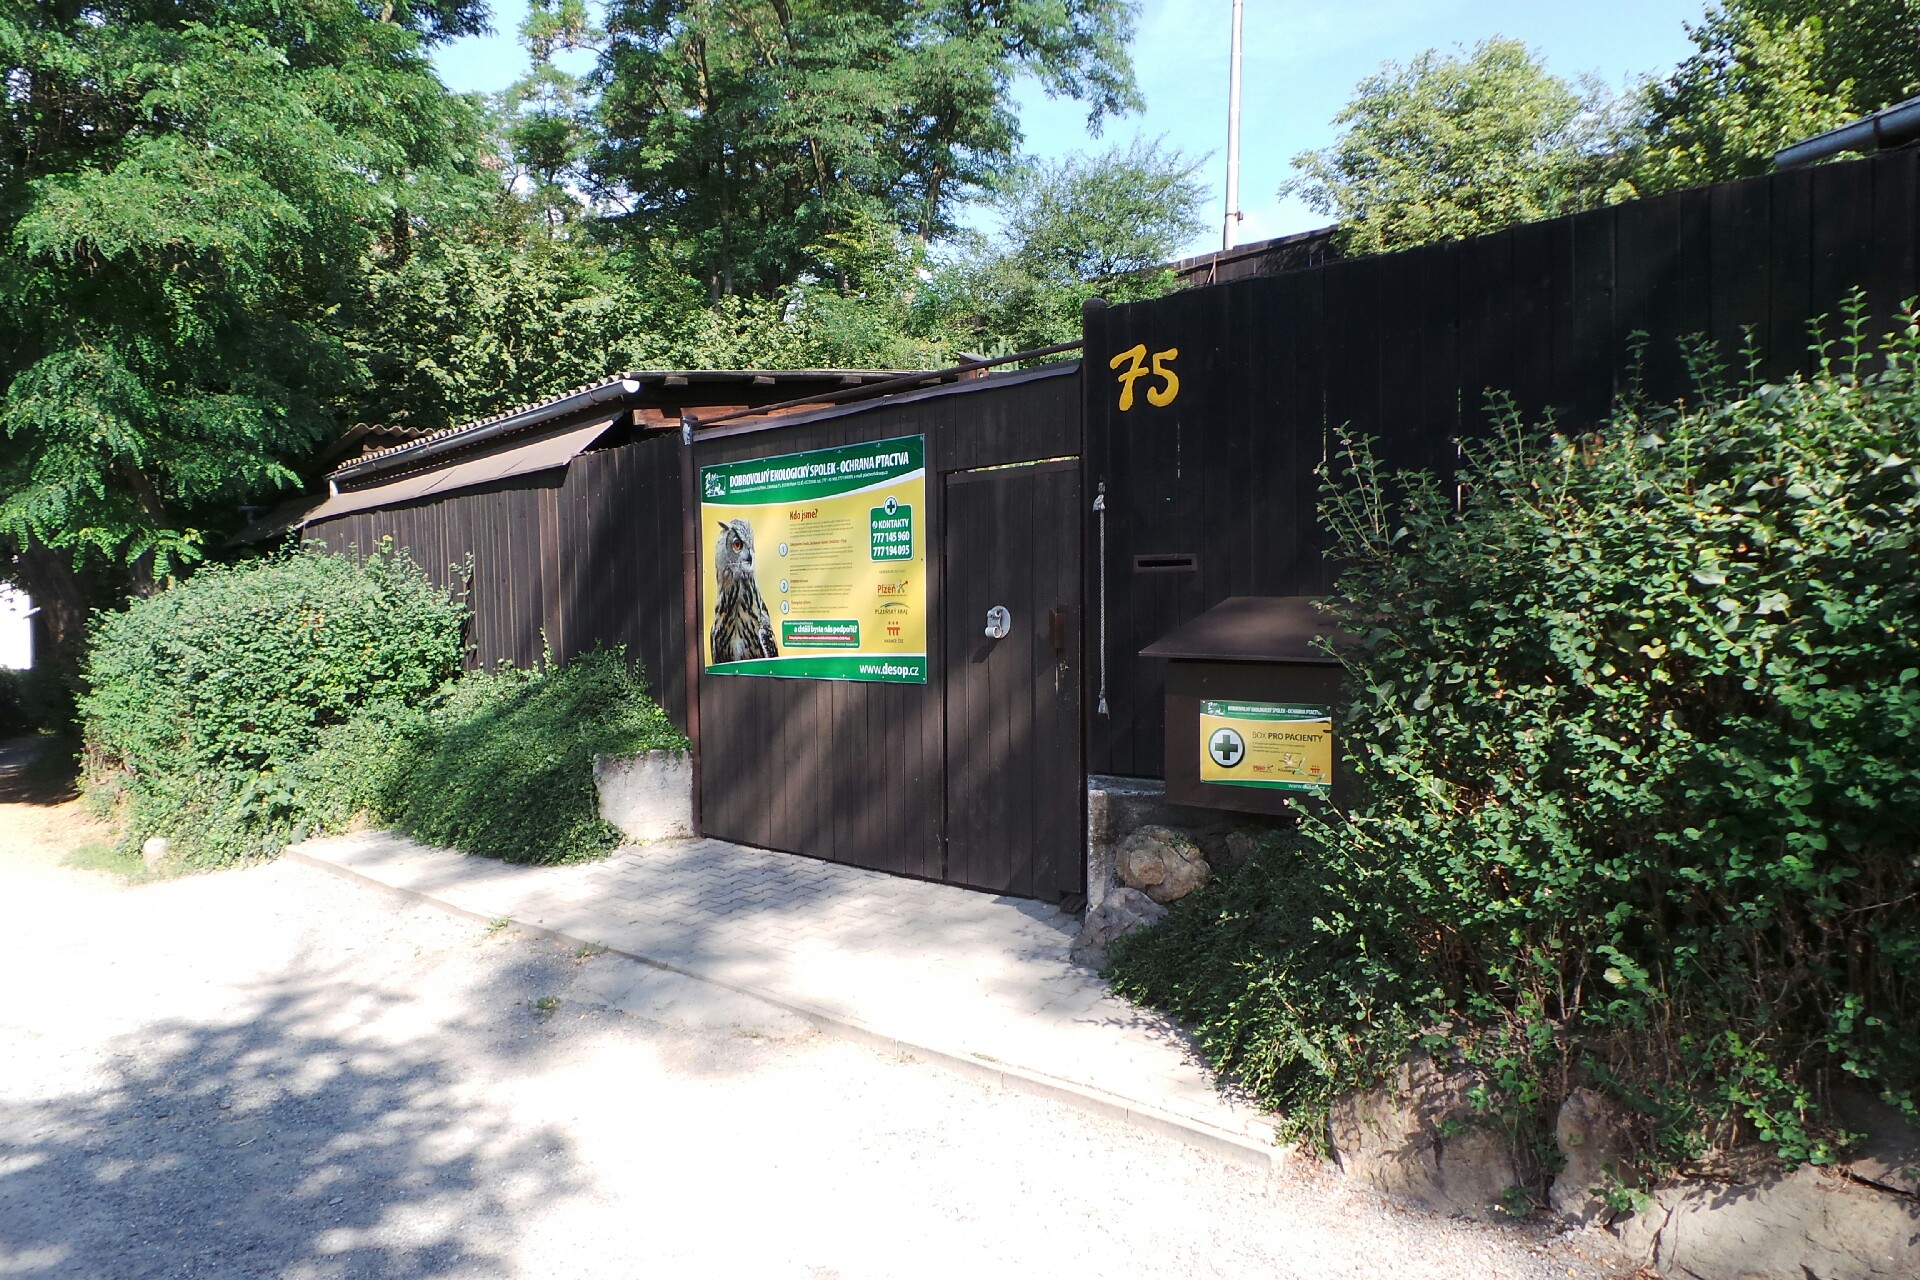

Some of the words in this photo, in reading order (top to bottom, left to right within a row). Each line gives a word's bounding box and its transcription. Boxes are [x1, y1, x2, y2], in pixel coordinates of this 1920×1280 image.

[1109, 343, 1180, 411] 75
[729, 468, 769, 487] DOBROVOLNÝ
[770, 463, 810, 482] EKOLOGICKÝ
[810, 461, 836, 476] SPOLEK
[840, 456, 874, 473] OCHRANA
[875, 451, 909, 468] PTACTVA
[789, 510, 800, 520] Kdo
[801, 508, 818, 521] jsme?
[878, 518, 909, 529] KONTAKTY
[873, 532, 885, 544] 777
[885, 531, 897, 542] 145
[898, 530, 910, 541] 960
[873, 545, 885, 557] 777
[885, 544, 897, 556] 194
[897, 544, 910, 555] 095
[877, 584, 896, 594] Plzeň
[859, 662, 919, 679] www.desop.cz
[1268, 732, 1284, 741] PRO
[1285, 733, 1323, 742] PACIENTY
